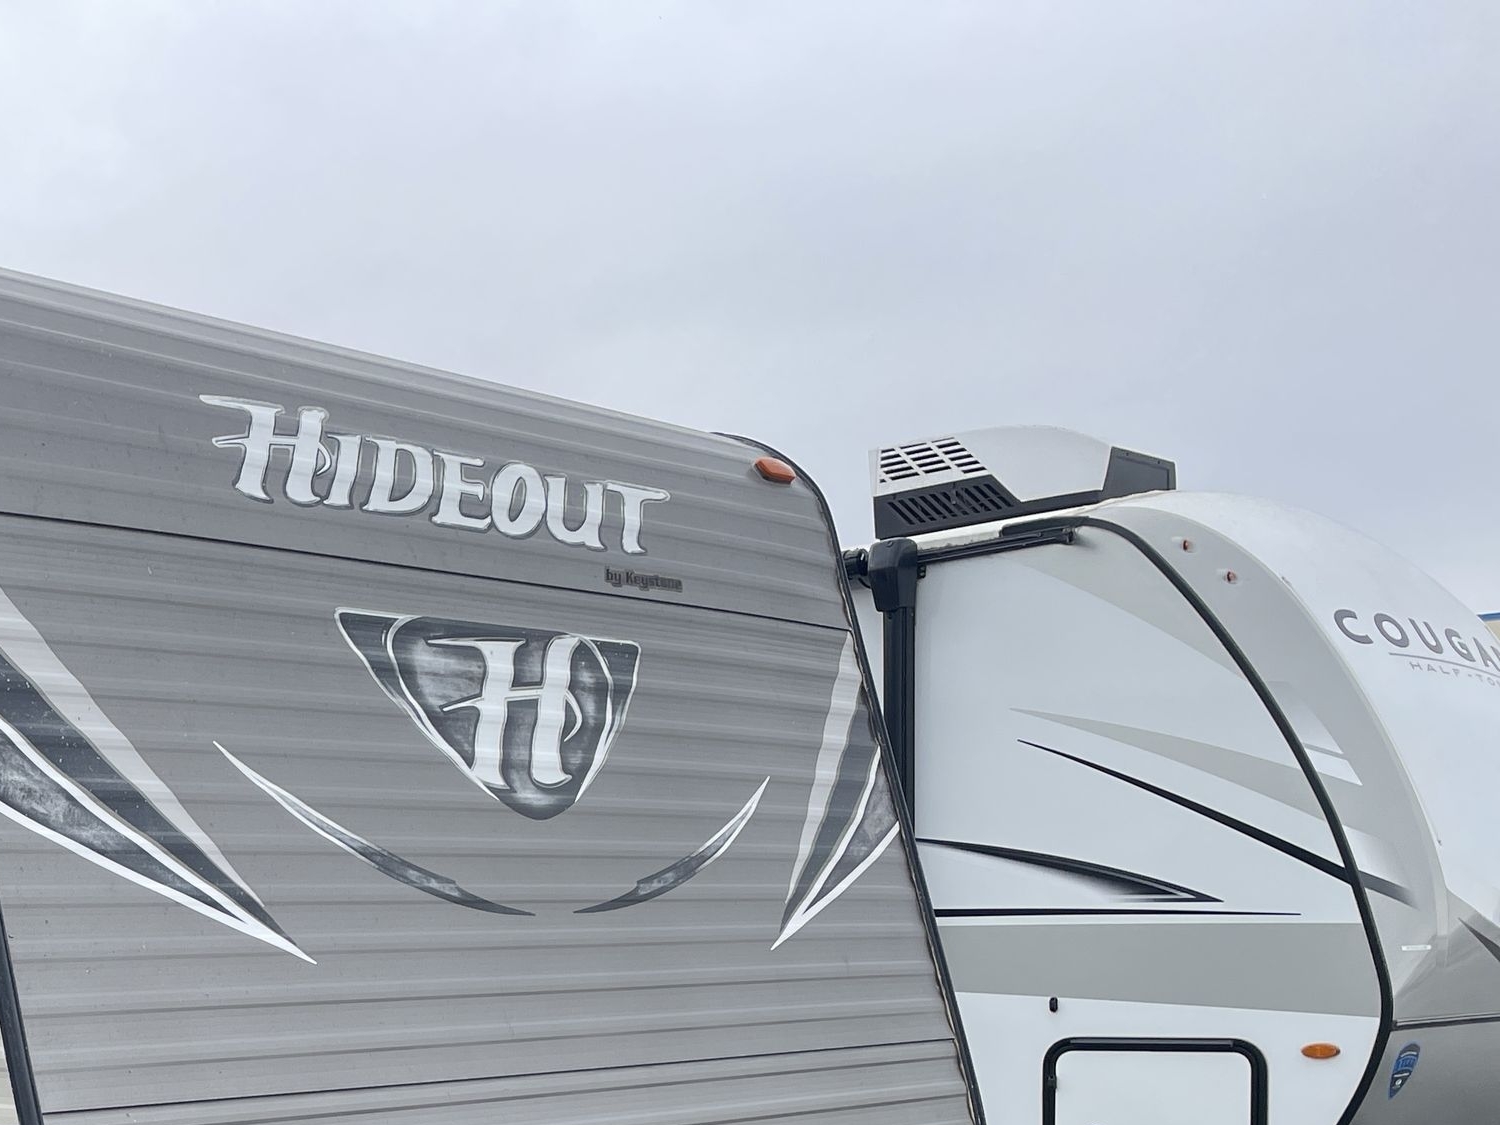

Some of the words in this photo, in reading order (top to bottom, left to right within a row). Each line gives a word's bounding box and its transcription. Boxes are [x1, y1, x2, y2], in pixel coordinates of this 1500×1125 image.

[199, 394, 671, 555] HIDEOUT
[605, 568, 622, 587] by
[625, 570, 683, 593] Keystone
[1409, 660, 1500, 687] HALF-TO
